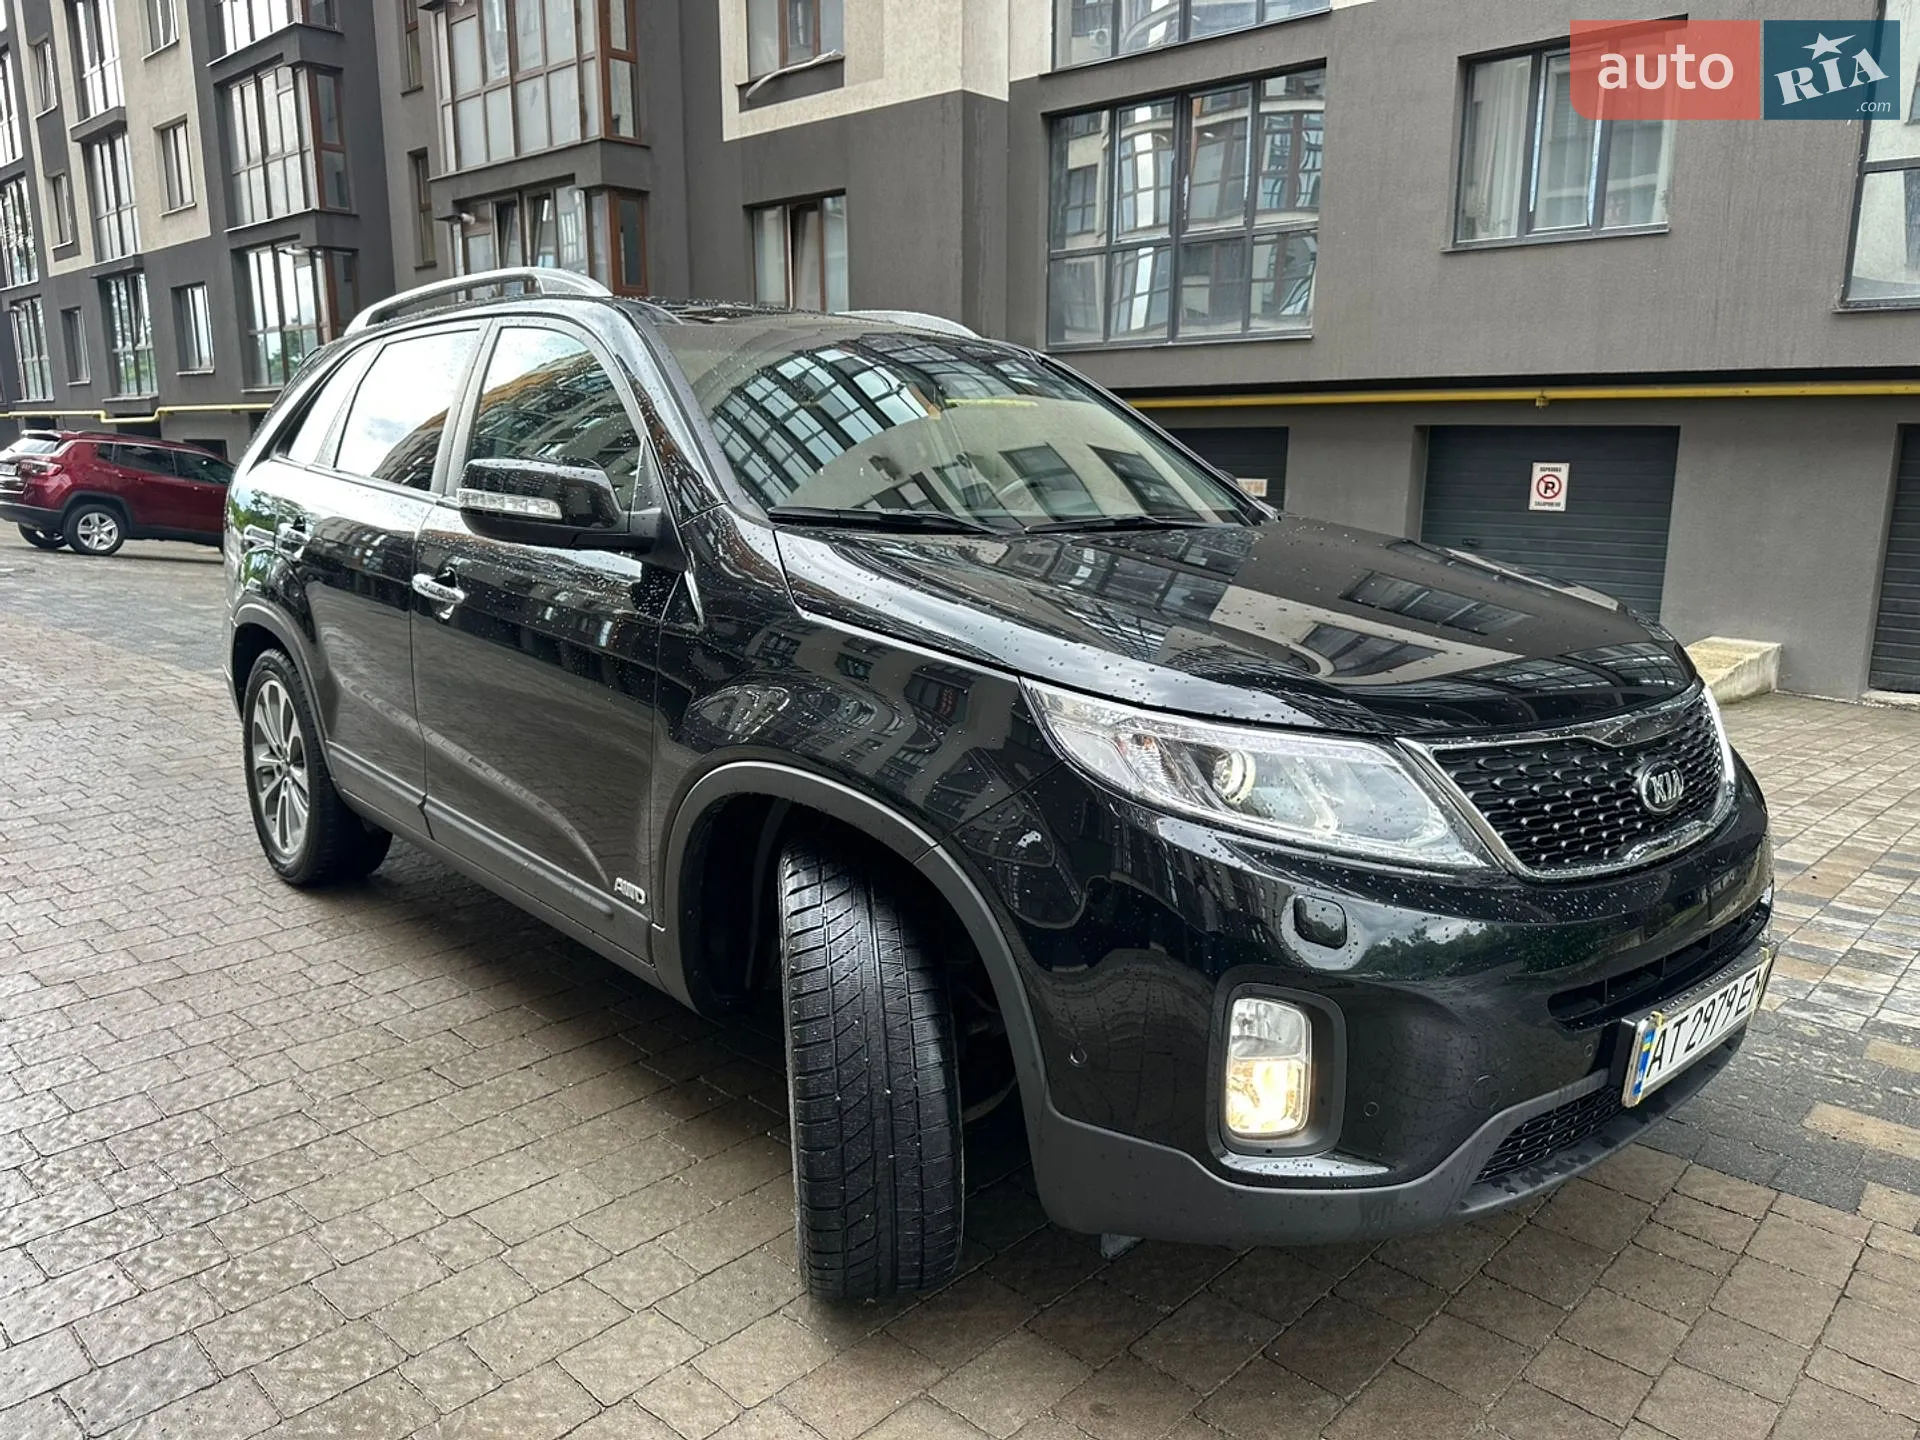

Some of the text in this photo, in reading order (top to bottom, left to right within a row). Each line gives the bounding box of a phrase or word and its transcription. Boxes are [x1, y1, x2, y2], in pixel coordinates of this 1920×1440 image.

[1649, 769, 1682, 804] KIA
[614, 877, 646, 905] AWD
[1684, 983, 1739, 1054] 2979
